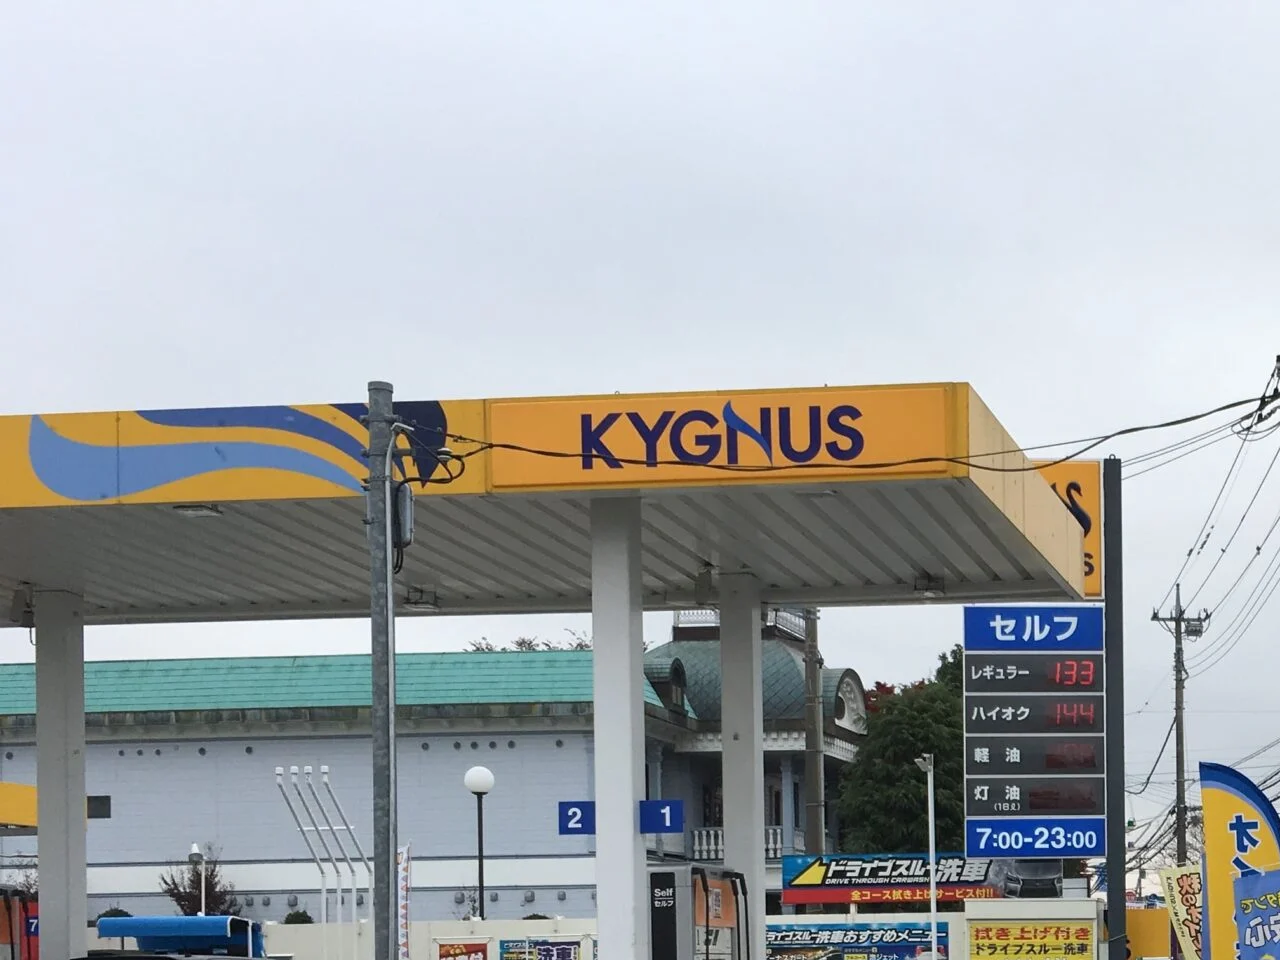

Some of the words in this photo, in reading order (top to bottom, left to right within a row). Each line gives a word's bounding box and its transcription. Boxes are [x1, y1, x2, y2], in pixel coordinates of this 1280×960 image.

[581, 400, 865, 470] KYGNUS
[990, 615, 1079, 641] セルフ
[972, 666, 1030, 680] レギュラー
[1056, 660, 1094, 685] 133
[972, 706, 1030, 721] ハイオク
[1056, 704, 1094, 724] 144
[568, 808, 582, 828] 2
[660, 805, 670, 826] 1
[976, 827, 1097, 850] 7:00-23:00
[654, 888, 674, 898] Self
[654, 900, 674, 908] セルフ
[29, 918, 38, 932] 7
[975, 927, 1090, 941] 拭き上げ付き
[976, 943, 1088, 956] ドライブスルー洗車
